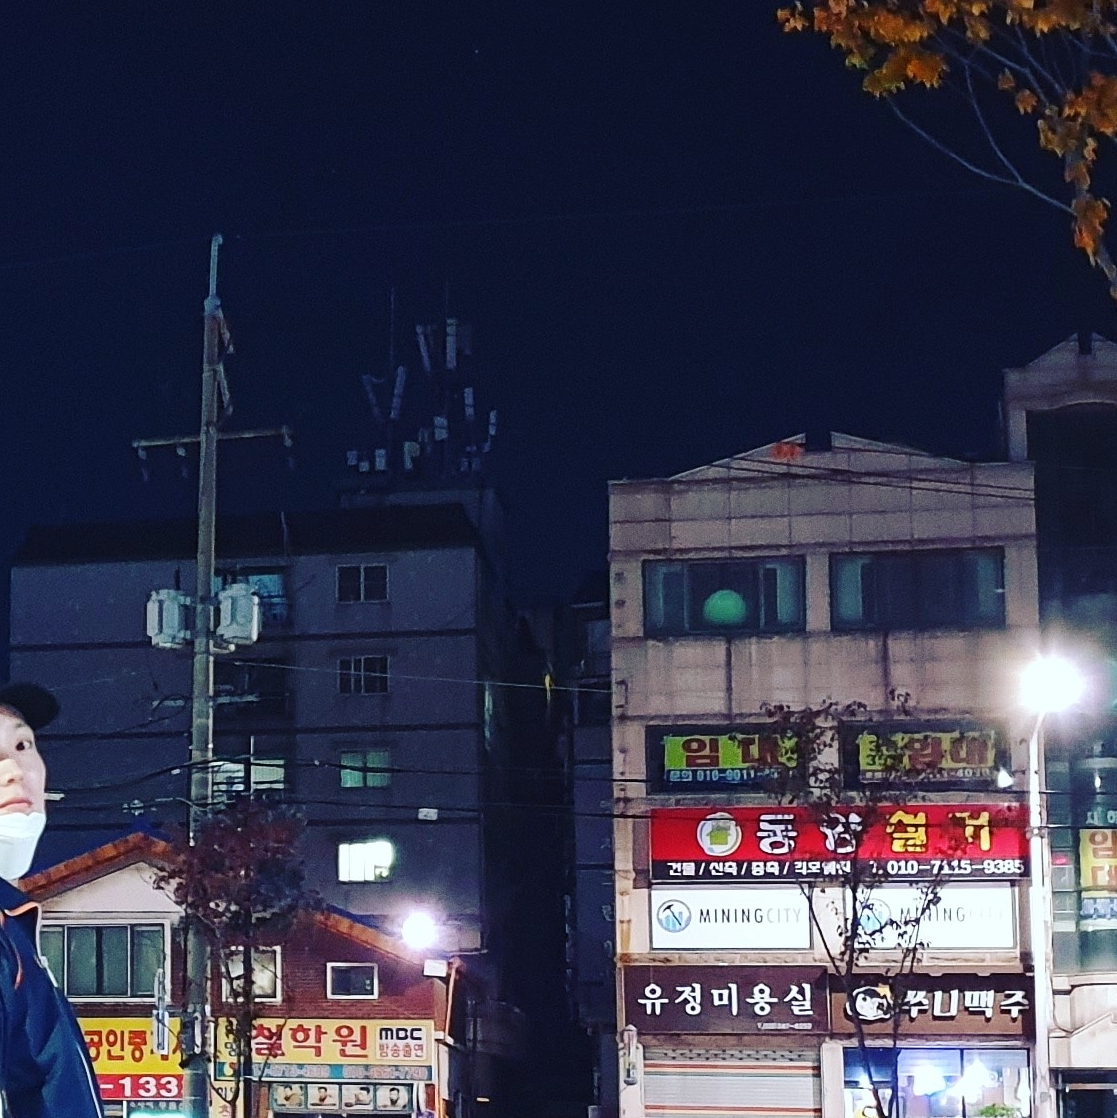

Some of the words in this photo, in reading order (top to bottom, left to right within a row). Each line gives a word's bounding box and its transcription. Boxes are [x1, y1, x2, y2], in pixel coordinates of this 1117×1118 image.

[682, 737, 782, 767] 임대
[887, 860, 1024, 875] 010-7115-9385
[637, 982, 814, 1017] 유정미용실
[84, 1028, 181, 1062] 공인중
[252, 1023, 370, 1059] 철학원
